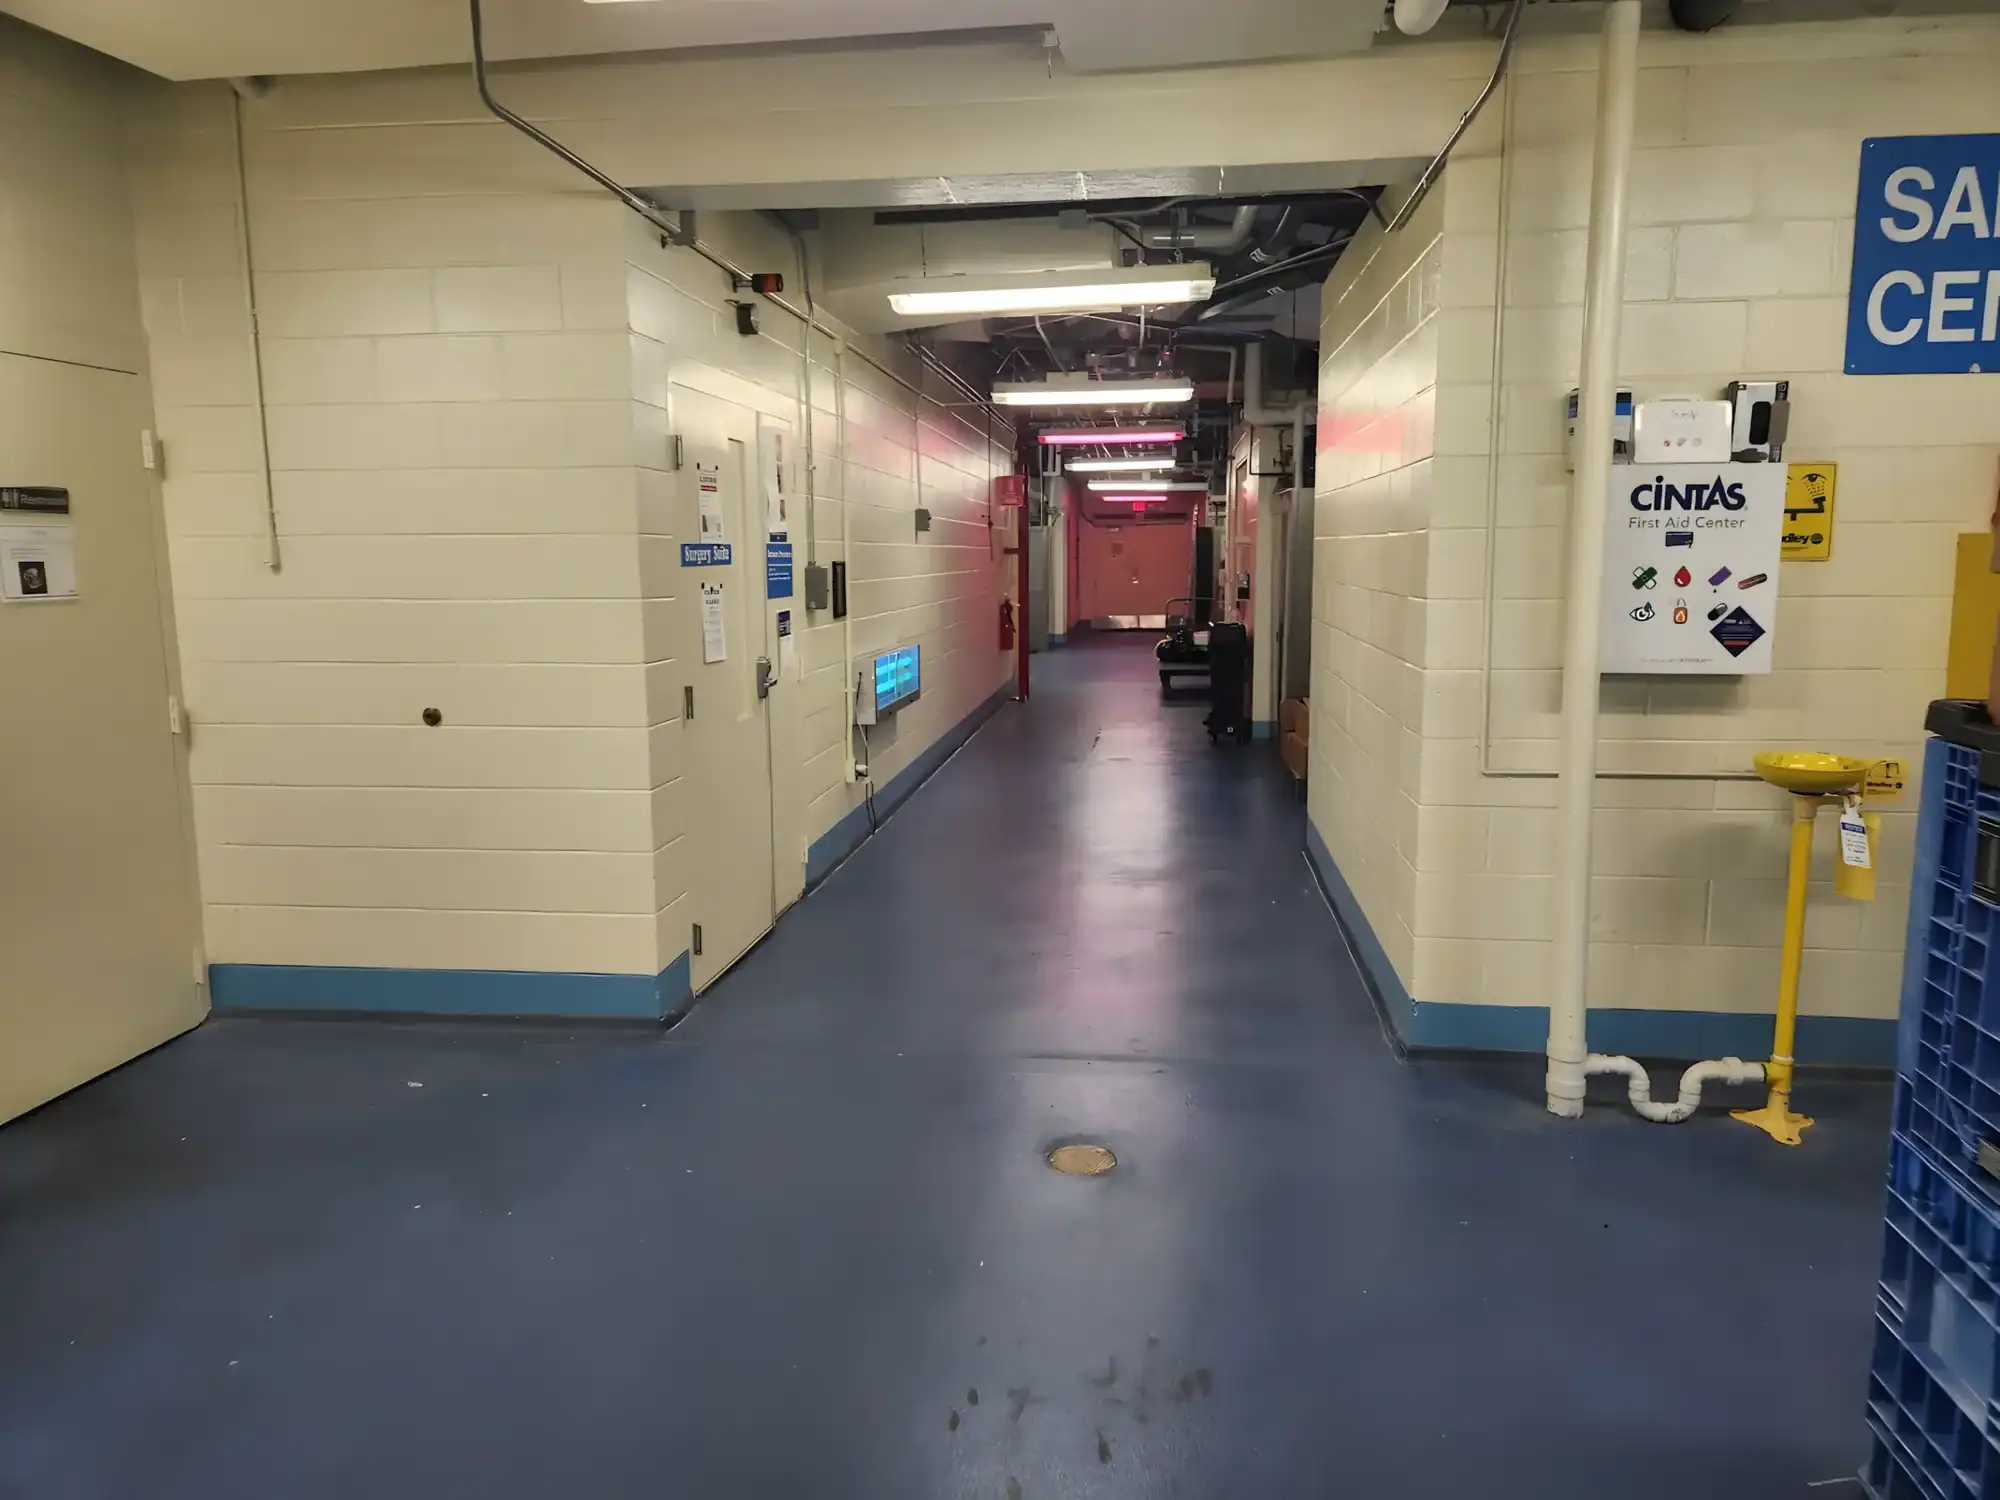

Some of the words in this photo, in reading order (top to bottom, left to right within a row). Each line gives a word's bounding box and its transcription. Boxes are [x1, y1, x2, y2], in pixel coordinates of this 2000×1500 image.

[1880, 166, 2000, 243] SA
[1629, 517, 1659, 529] First
[1665, 516, 1690, 529] Aid
[1695, 517, 1746, 529] Center
[685, 546, 711, 564] Surgery
[713, 545, 730, 560] Suite
